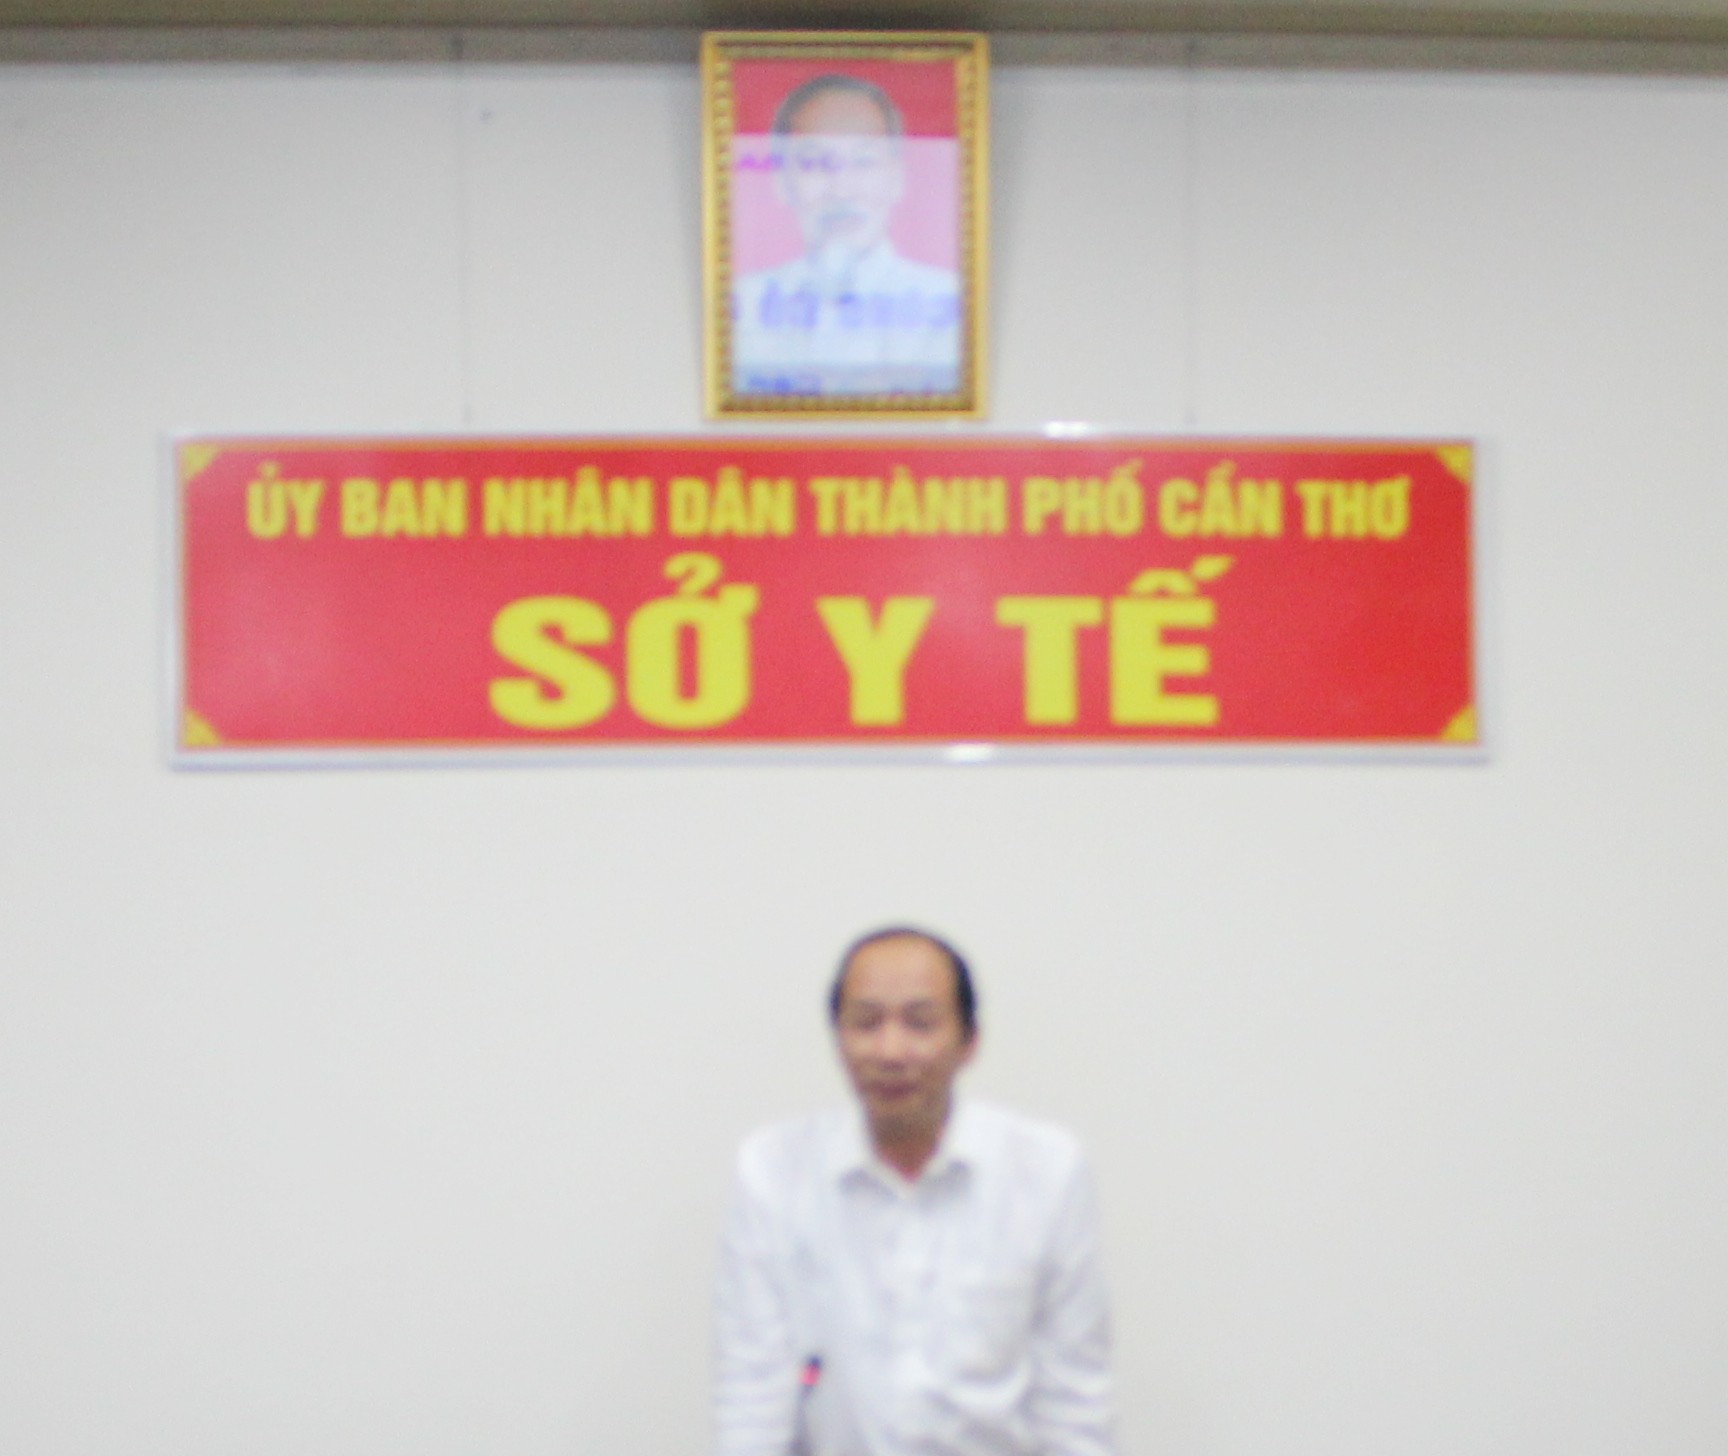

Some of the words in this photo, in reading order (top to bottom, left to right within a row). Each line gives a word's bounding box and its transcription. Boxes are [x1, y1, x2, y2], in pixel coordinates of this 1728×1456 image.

[246, 459, 325, 540] ỦY
[340, 477, 469, 539] BAN
[482, 464, 656, 538] NHÂN
[668, 464, 797, 537] DÂN
[808, 464, 1009, 536] THÀNH
[1022, 459, 1146, 537] PHỐ
[1295, 473, 1413, 540] THƠ
[488, 552, 761, 730] SỞ
[815, 595, 935, 727] Y
[994, 553, 1235, 727] TẾ
